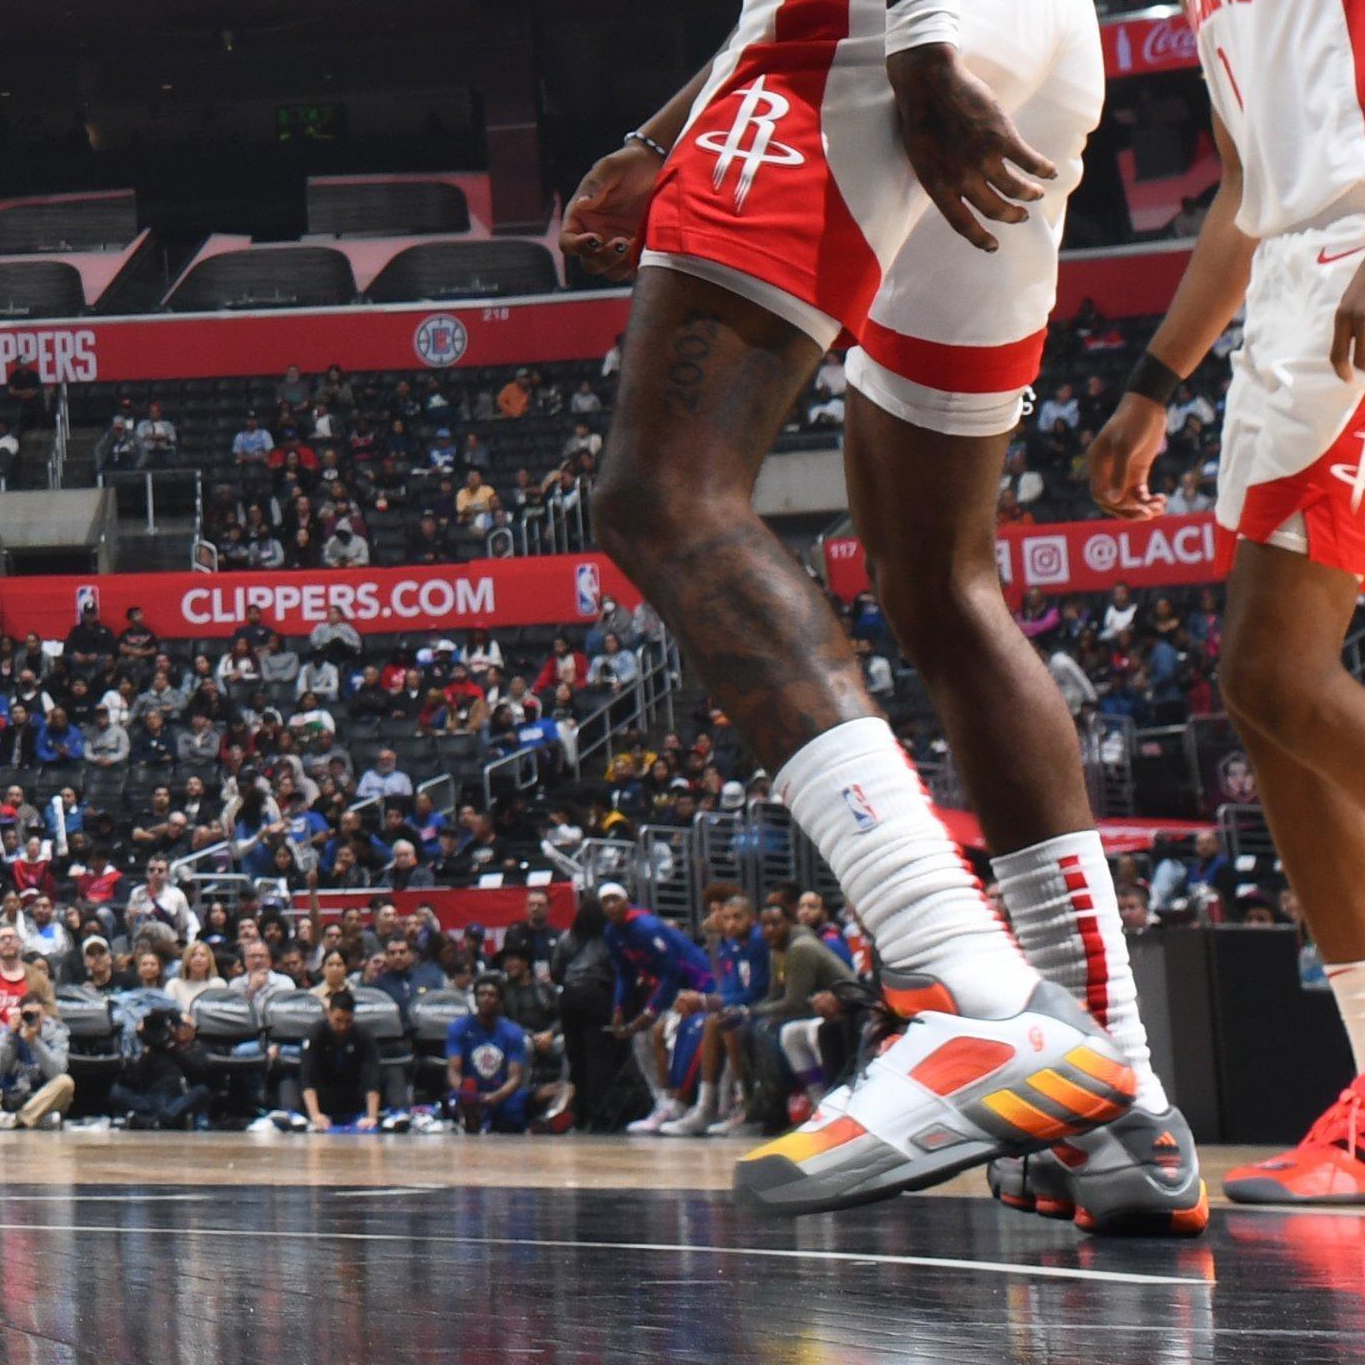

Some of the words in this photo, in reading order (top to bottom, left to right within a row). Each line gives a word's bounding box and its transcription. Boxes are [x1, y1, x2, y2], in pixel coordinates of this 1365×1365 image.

[1217, 46, 1245, 113] 1
[829, 542, 858, 560] 117
[180, 576, 495, 625] CLIPPERS.COM
